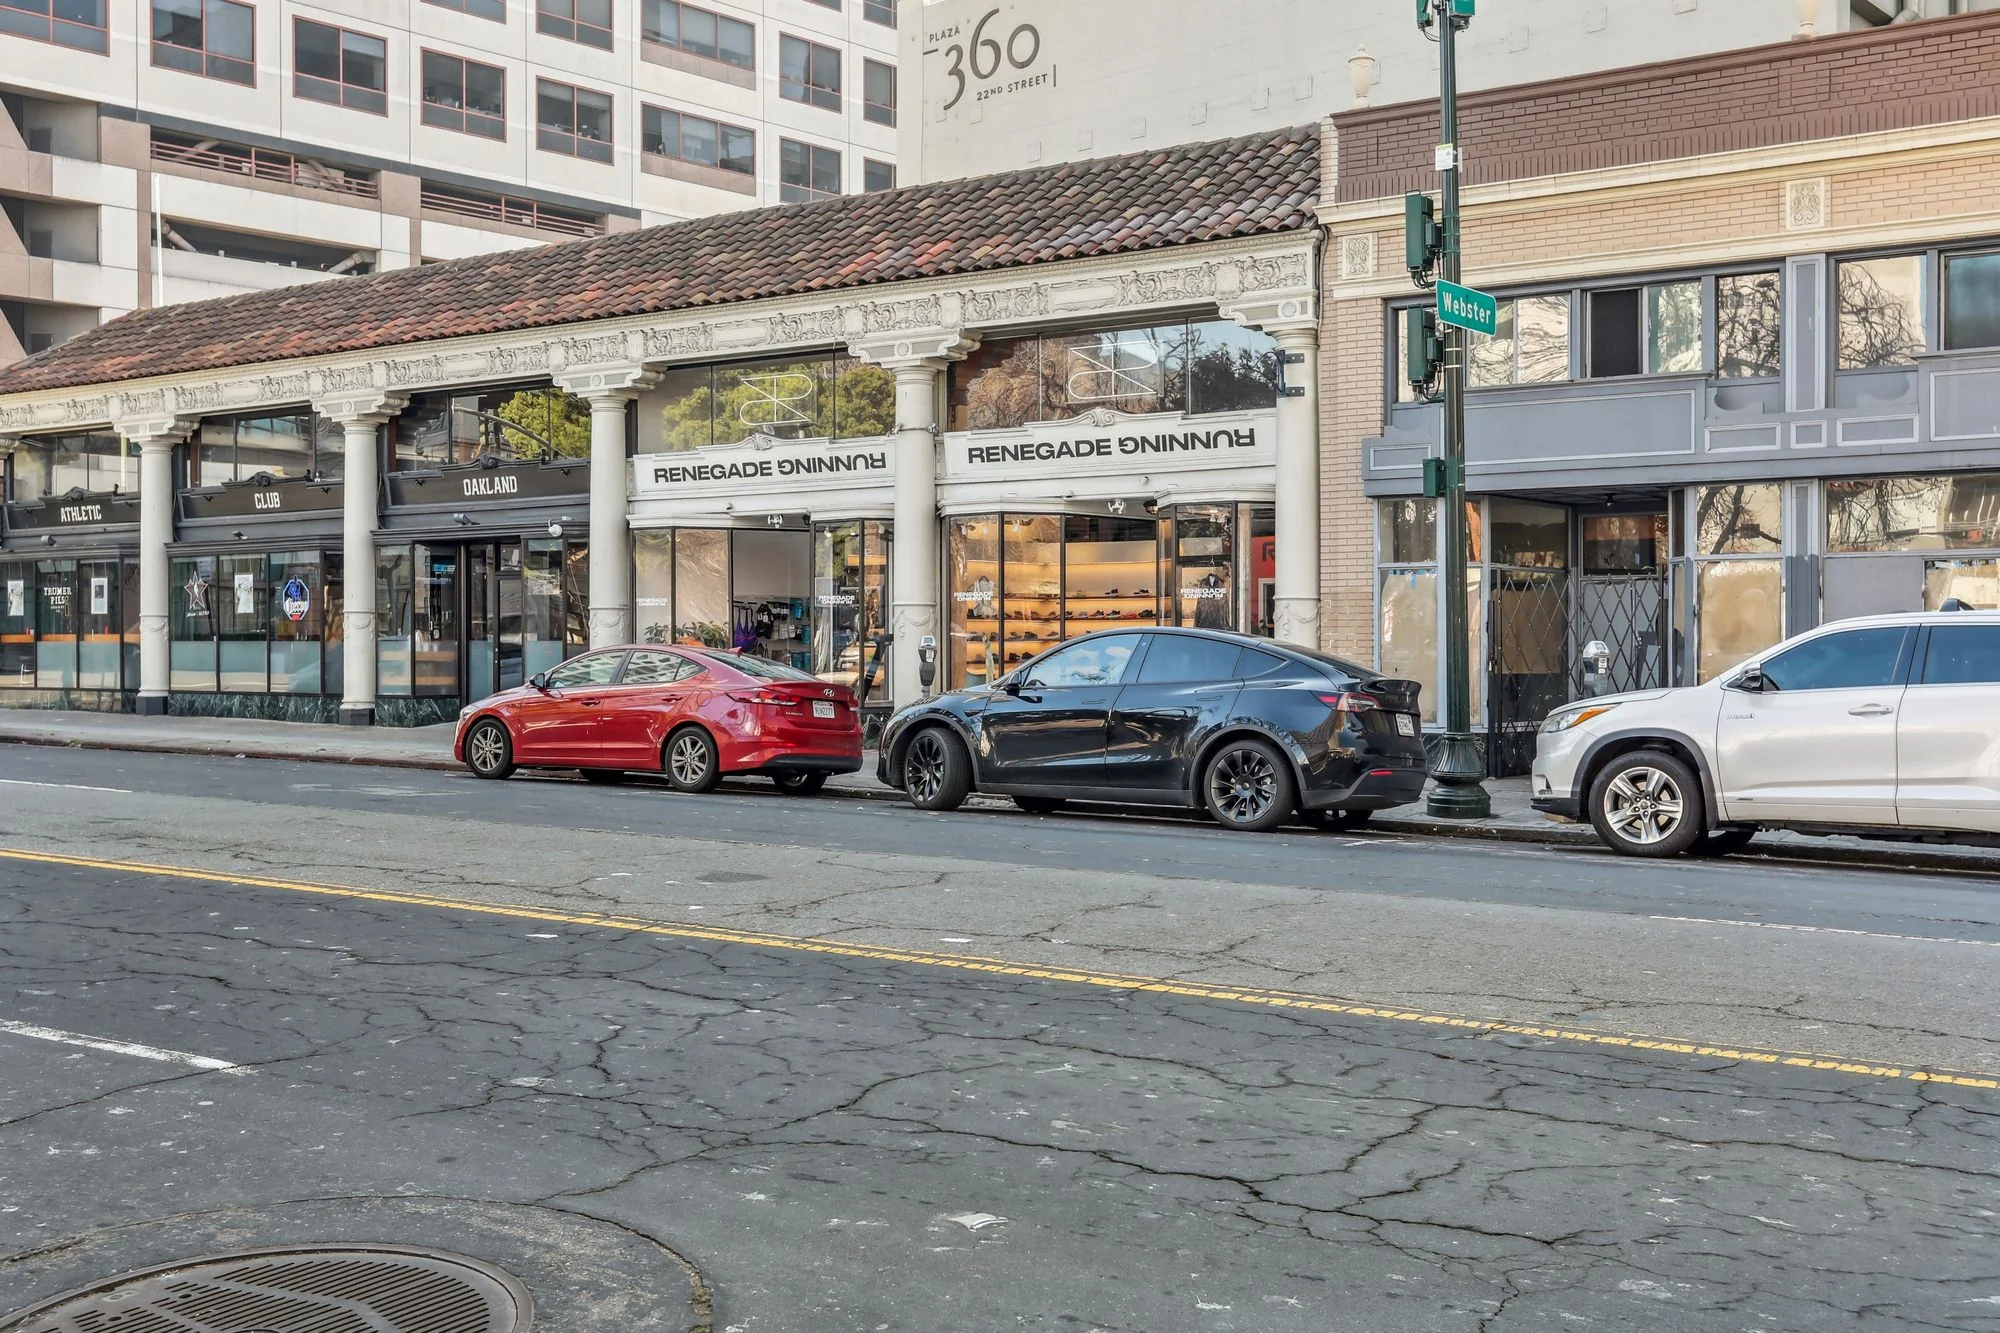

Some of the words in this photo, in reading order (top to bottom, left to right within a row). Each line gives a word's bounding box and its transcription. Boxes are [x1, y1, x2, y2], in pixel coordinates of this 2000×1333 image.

[929, 26, 960, 43] PLAZA
[943, 8, 1040, 111] 360
[976, 86, 1003, 101] 22ND
[1007, 74, 1048, 93] STREET
[1442, 291, 1491, 324] Webster
[968, 438, 1112, 464] RENEGADE
[1118, 428, 1255, 455] RUNNING
[653, 460, 773, 484] RENEGADE
[777, 452, 887, 475] RUNNING
[463, 475, 518, 496] OAKLAND
[254, 491, 280, 509] CLUB
[60, 504, 102, 523] ATHLETIC
[43, 586, 72, 596] TRUMER
[50, 595, 66, 605] PILS
